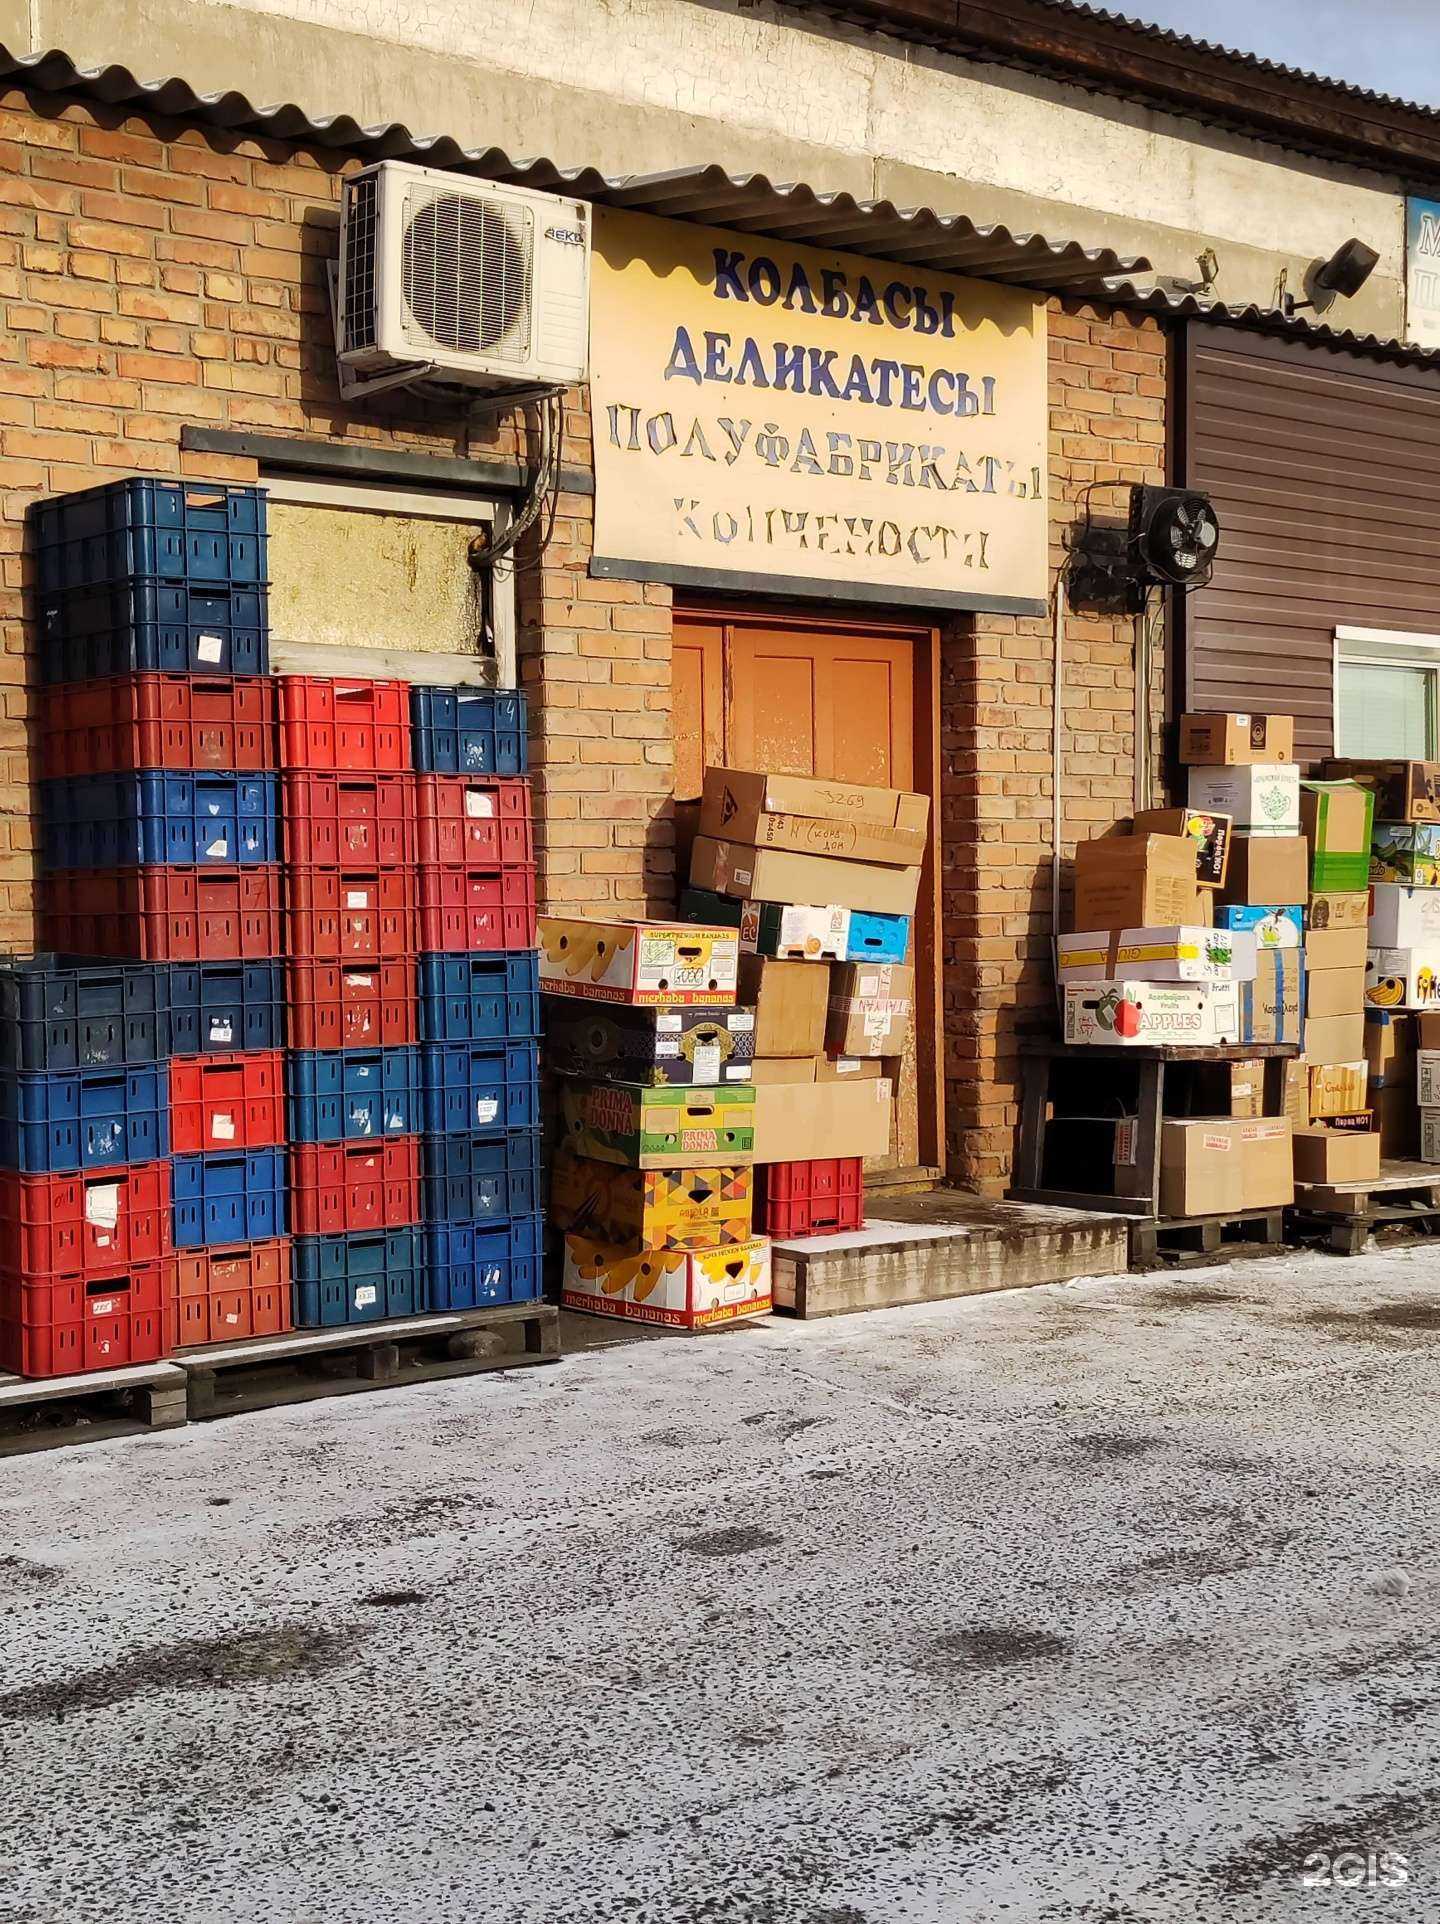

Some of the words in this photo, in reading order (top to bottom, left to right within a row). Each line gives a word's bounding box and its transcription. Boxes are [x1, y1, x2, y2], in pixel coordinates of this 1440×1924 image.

[711, 247, 956, 338] КОЛБАСЫ
[663, 325, 997, 417] ДЕЛИКАТЕСЫ
[605, 402, 1043, 500] ПОЛУФАБРИКАТЫ
[638, 991, 685, 1004] merhaba
[692, 991, 735, 1004] bananas
[1140, 1013, 1201, 1030] APPLES
[591, 1085, 632, 1114] PRIMA
[591, 1108, 634, 1136] DONNA
[682, 1129, 717, 1141] PRIMA
[682, 1140, 717, 1151] DONNA
[565, 1293, 616, 1314] merhaba
[625, 1303, 681, 1324] bananas
[693, 1306, 733, 1325] merhaba
[736, 1299, 770, 1315] bananas
